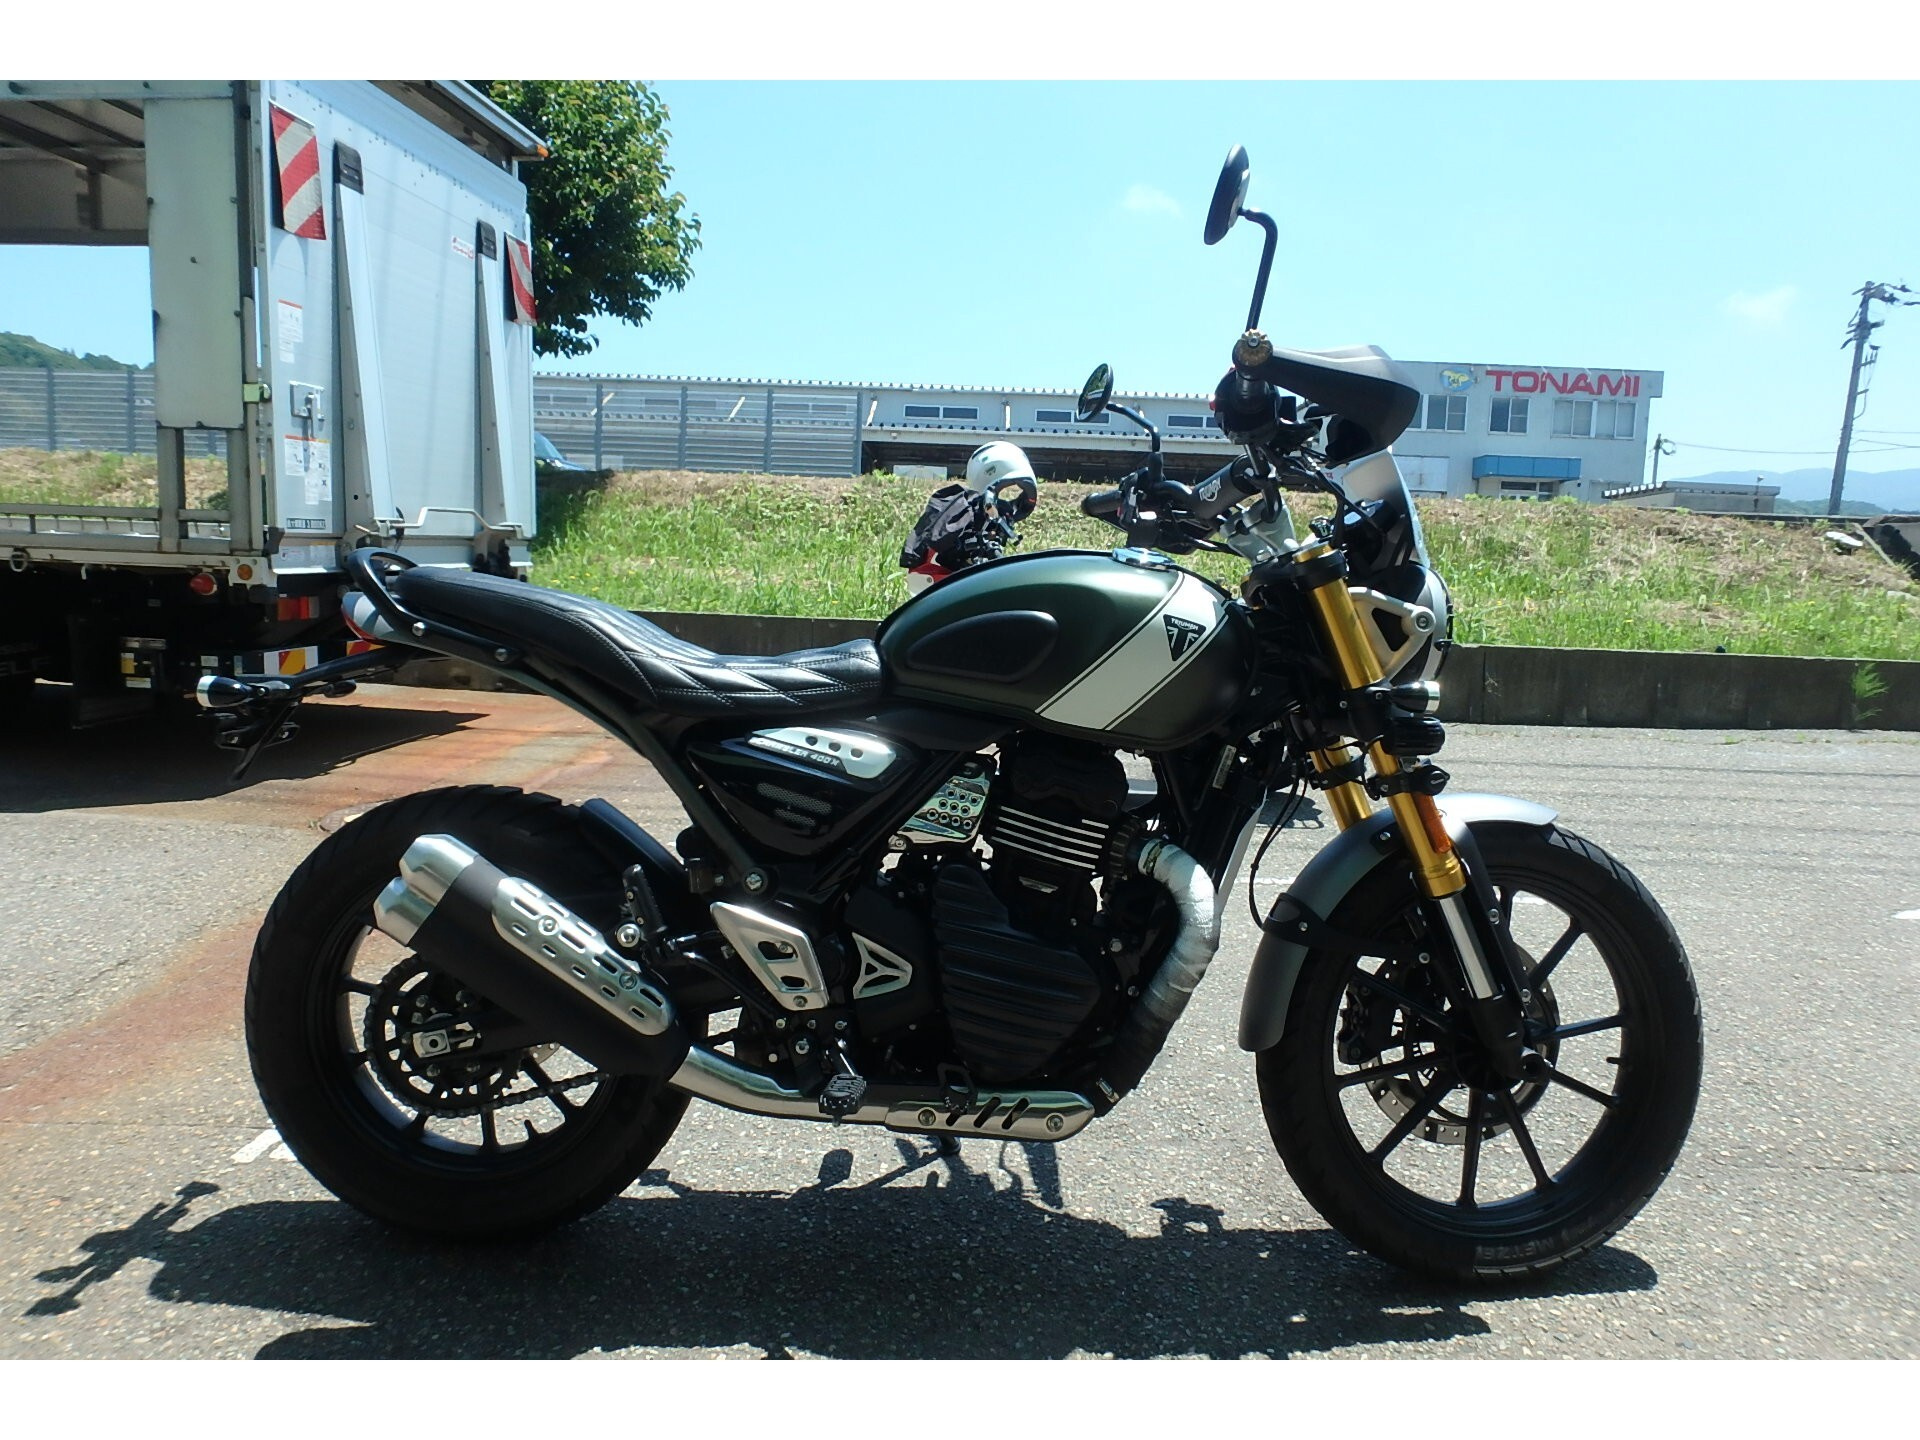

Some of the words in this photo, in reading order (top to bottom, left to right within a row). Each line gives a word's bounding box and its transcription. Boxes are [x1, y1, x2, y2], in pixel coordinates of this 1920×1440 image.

[1486, 370, 1640, 397] TONAMI
[1171, 617, 1198, 630] TRIUMPH
[810, 753, 840, 767] 400X
